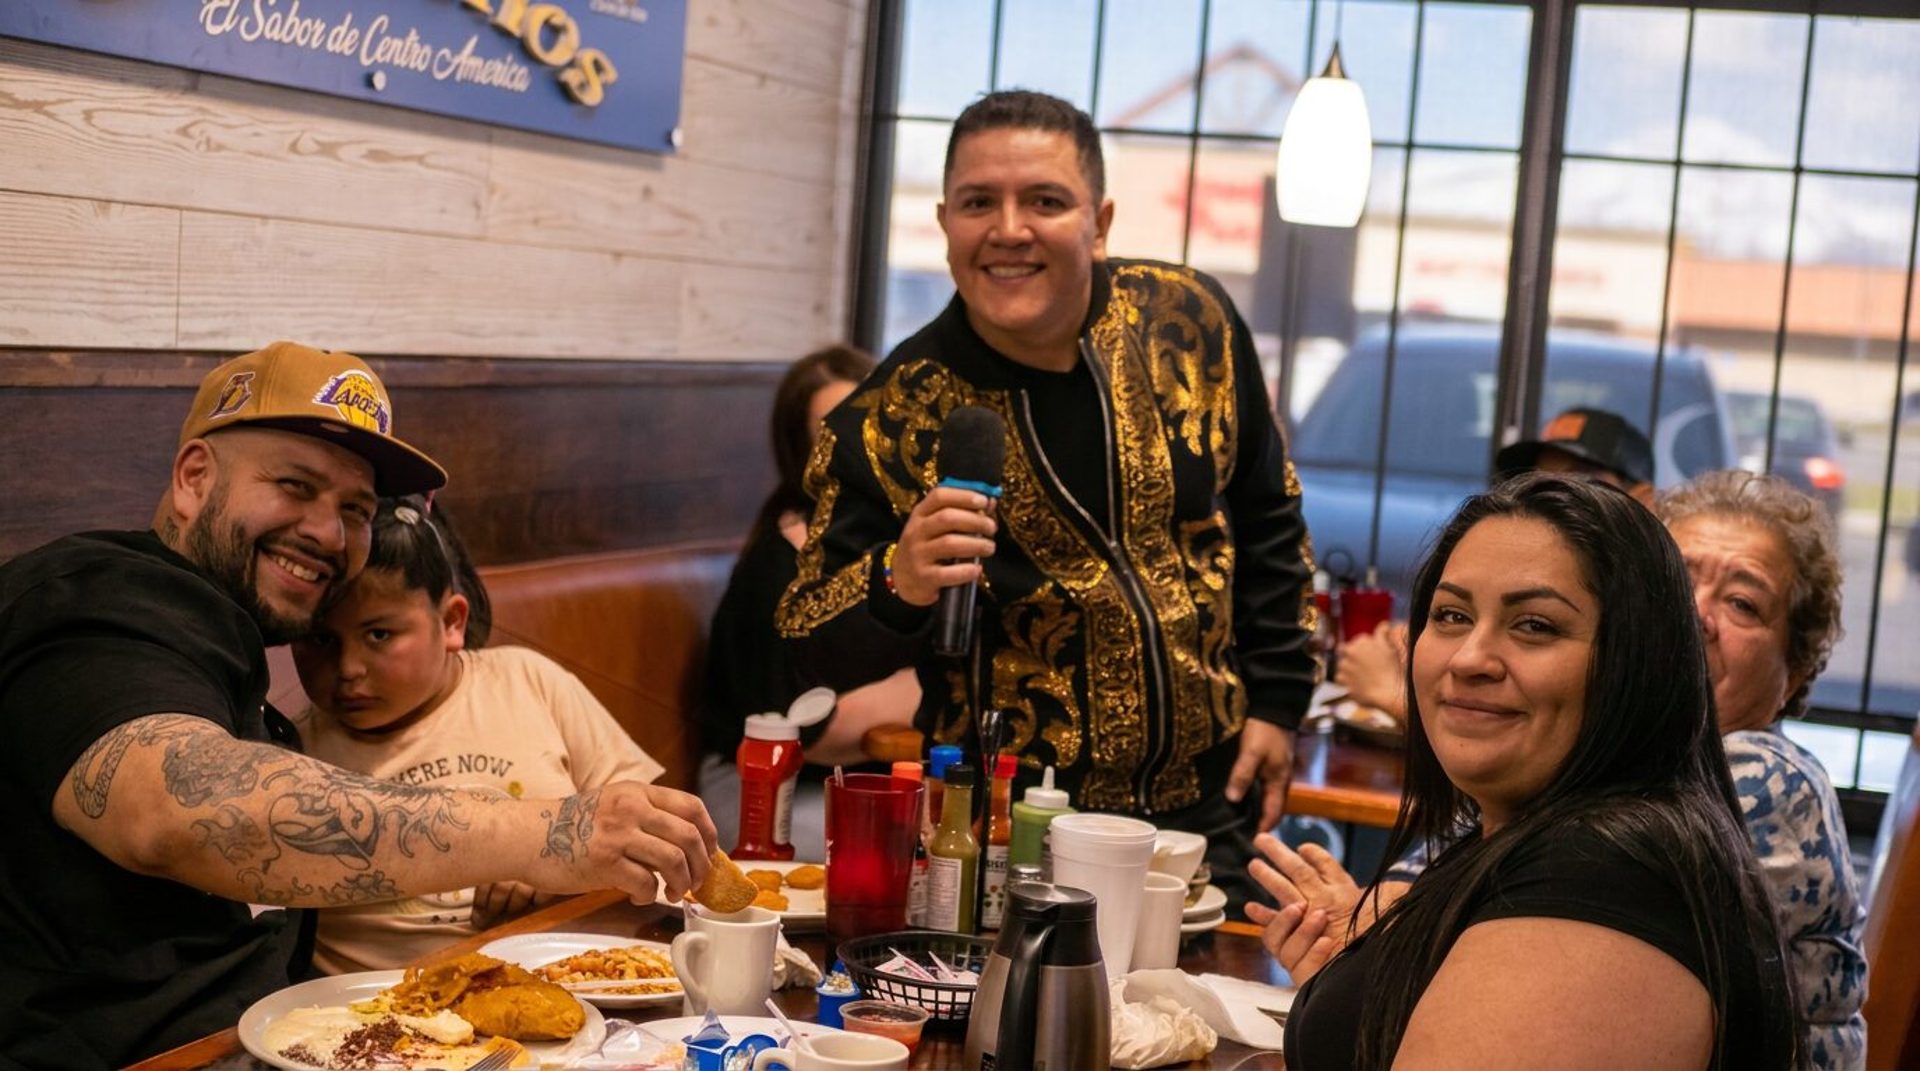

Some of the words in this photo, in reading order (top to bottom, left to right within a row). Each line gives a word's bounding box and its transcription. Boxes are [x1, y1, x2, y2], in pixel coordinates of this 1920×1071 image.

[199, 0, 240, 35] El
[239, 0, 327, 49] Sabor
[326, 12, 360, 56] de
[359, 14, 432, 72] Centro
[432, 34, 531, 92] America
[457, 753, 514, 778] NOW
